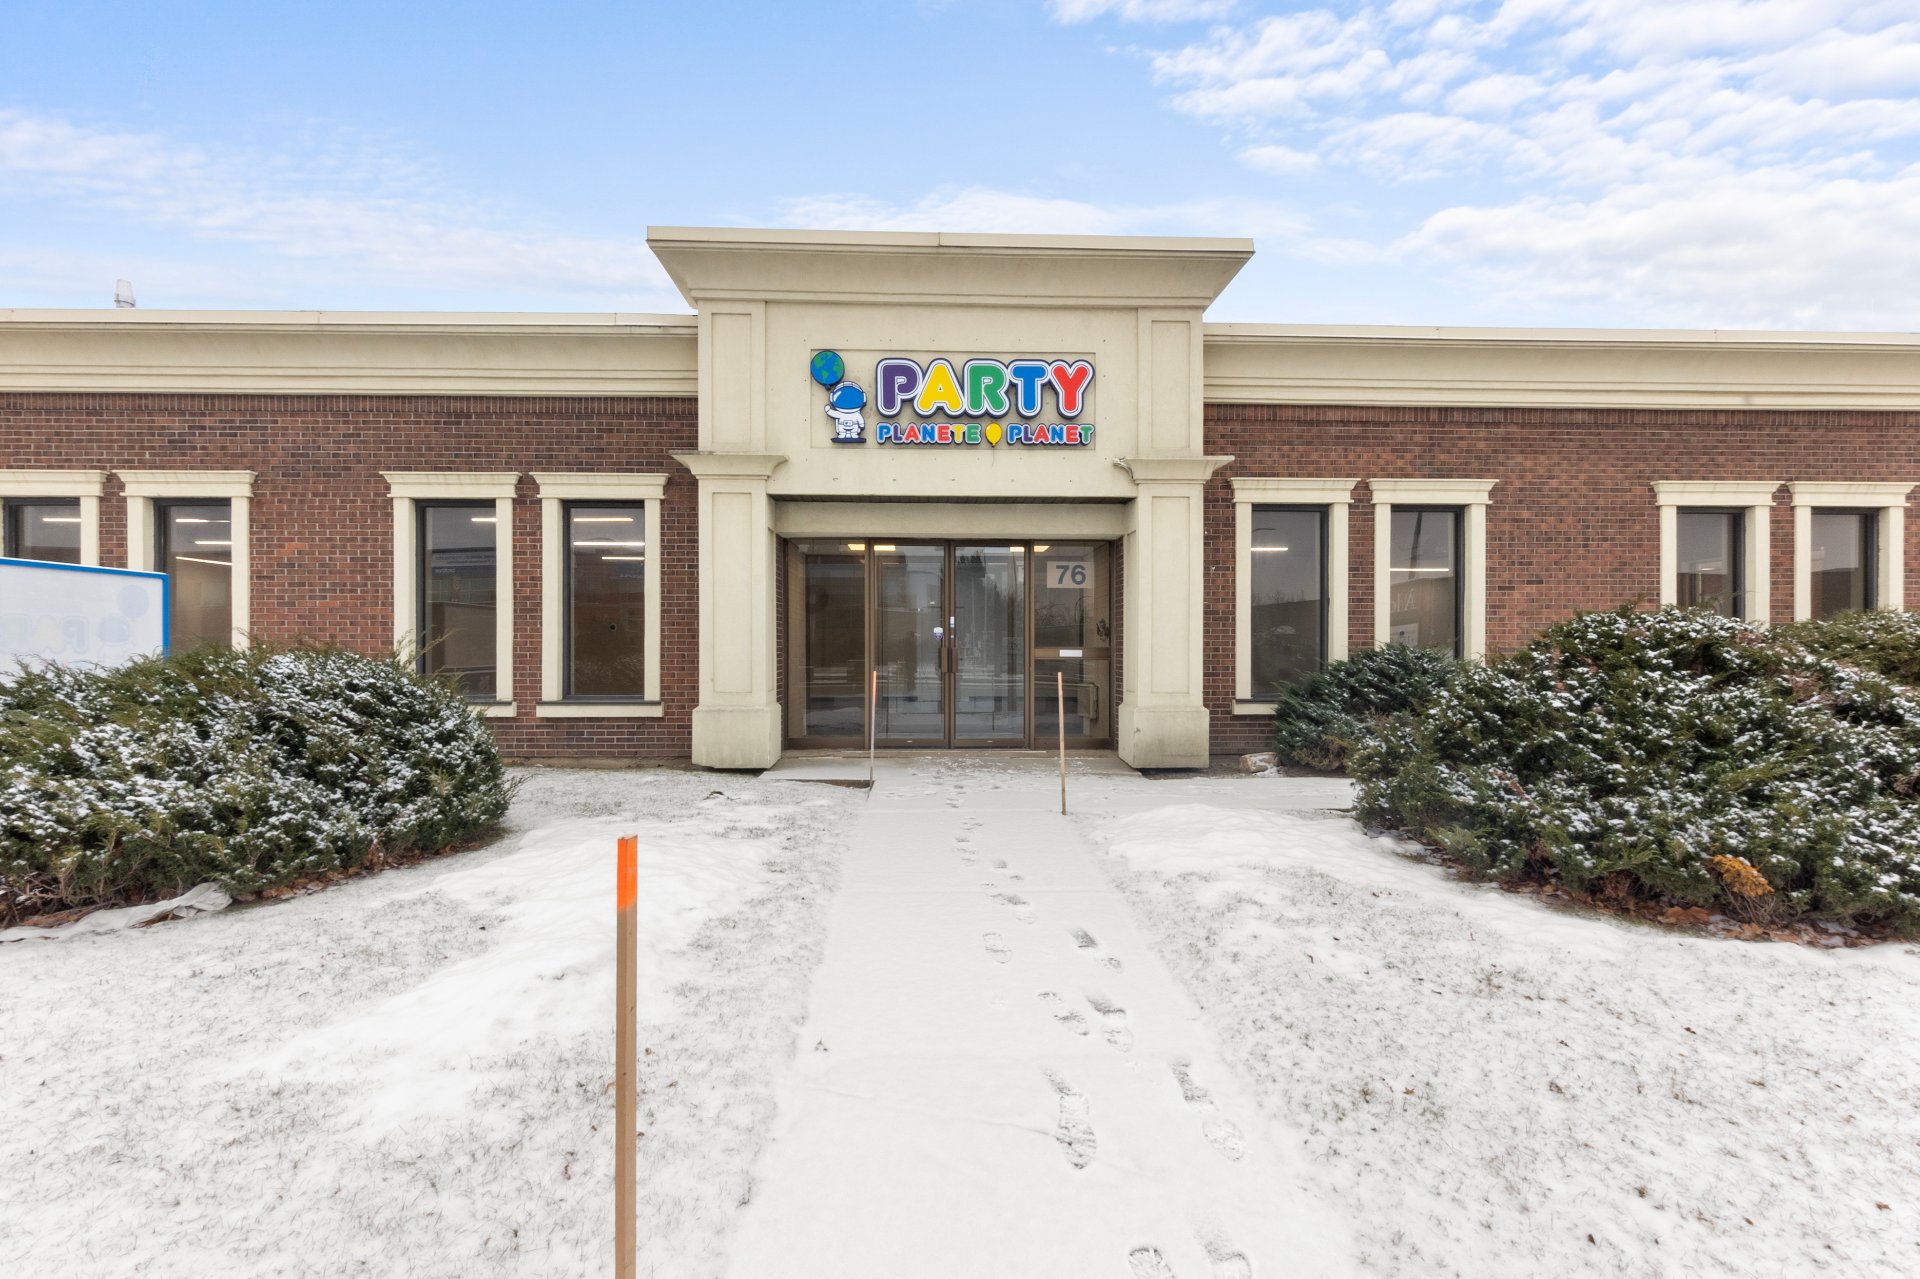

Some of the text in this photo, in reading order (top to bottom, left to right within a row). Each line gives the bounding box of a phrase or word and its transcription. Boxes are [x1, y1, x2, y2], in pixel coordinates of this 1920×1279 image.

[875, 357, 1095, 418] PARTY
[876, 423, 1095, 445] PLANETE PLANET
[1055, 564, 1086, 585] 76
